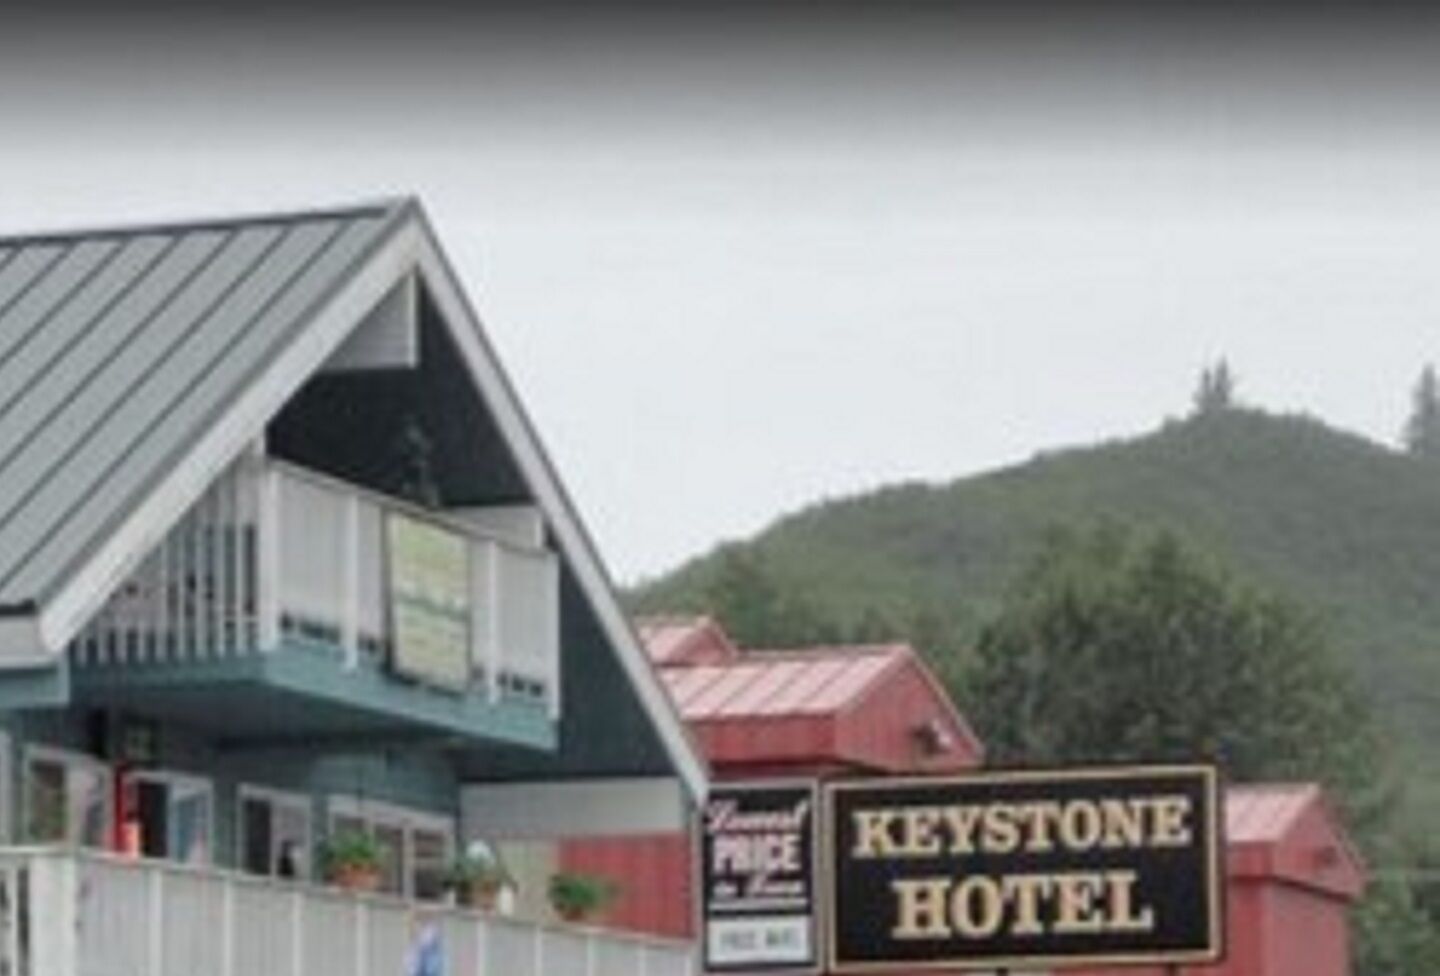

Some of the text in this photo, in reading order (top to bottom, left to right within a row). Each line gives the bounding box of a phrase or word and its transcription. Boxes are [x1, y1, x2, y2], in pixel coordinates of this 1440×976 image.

[713, 833, 803, 874] PRICE
[852, 796, 1192, 858] KEYSTONE
[891, 871, 1154, 940] HOTEL
